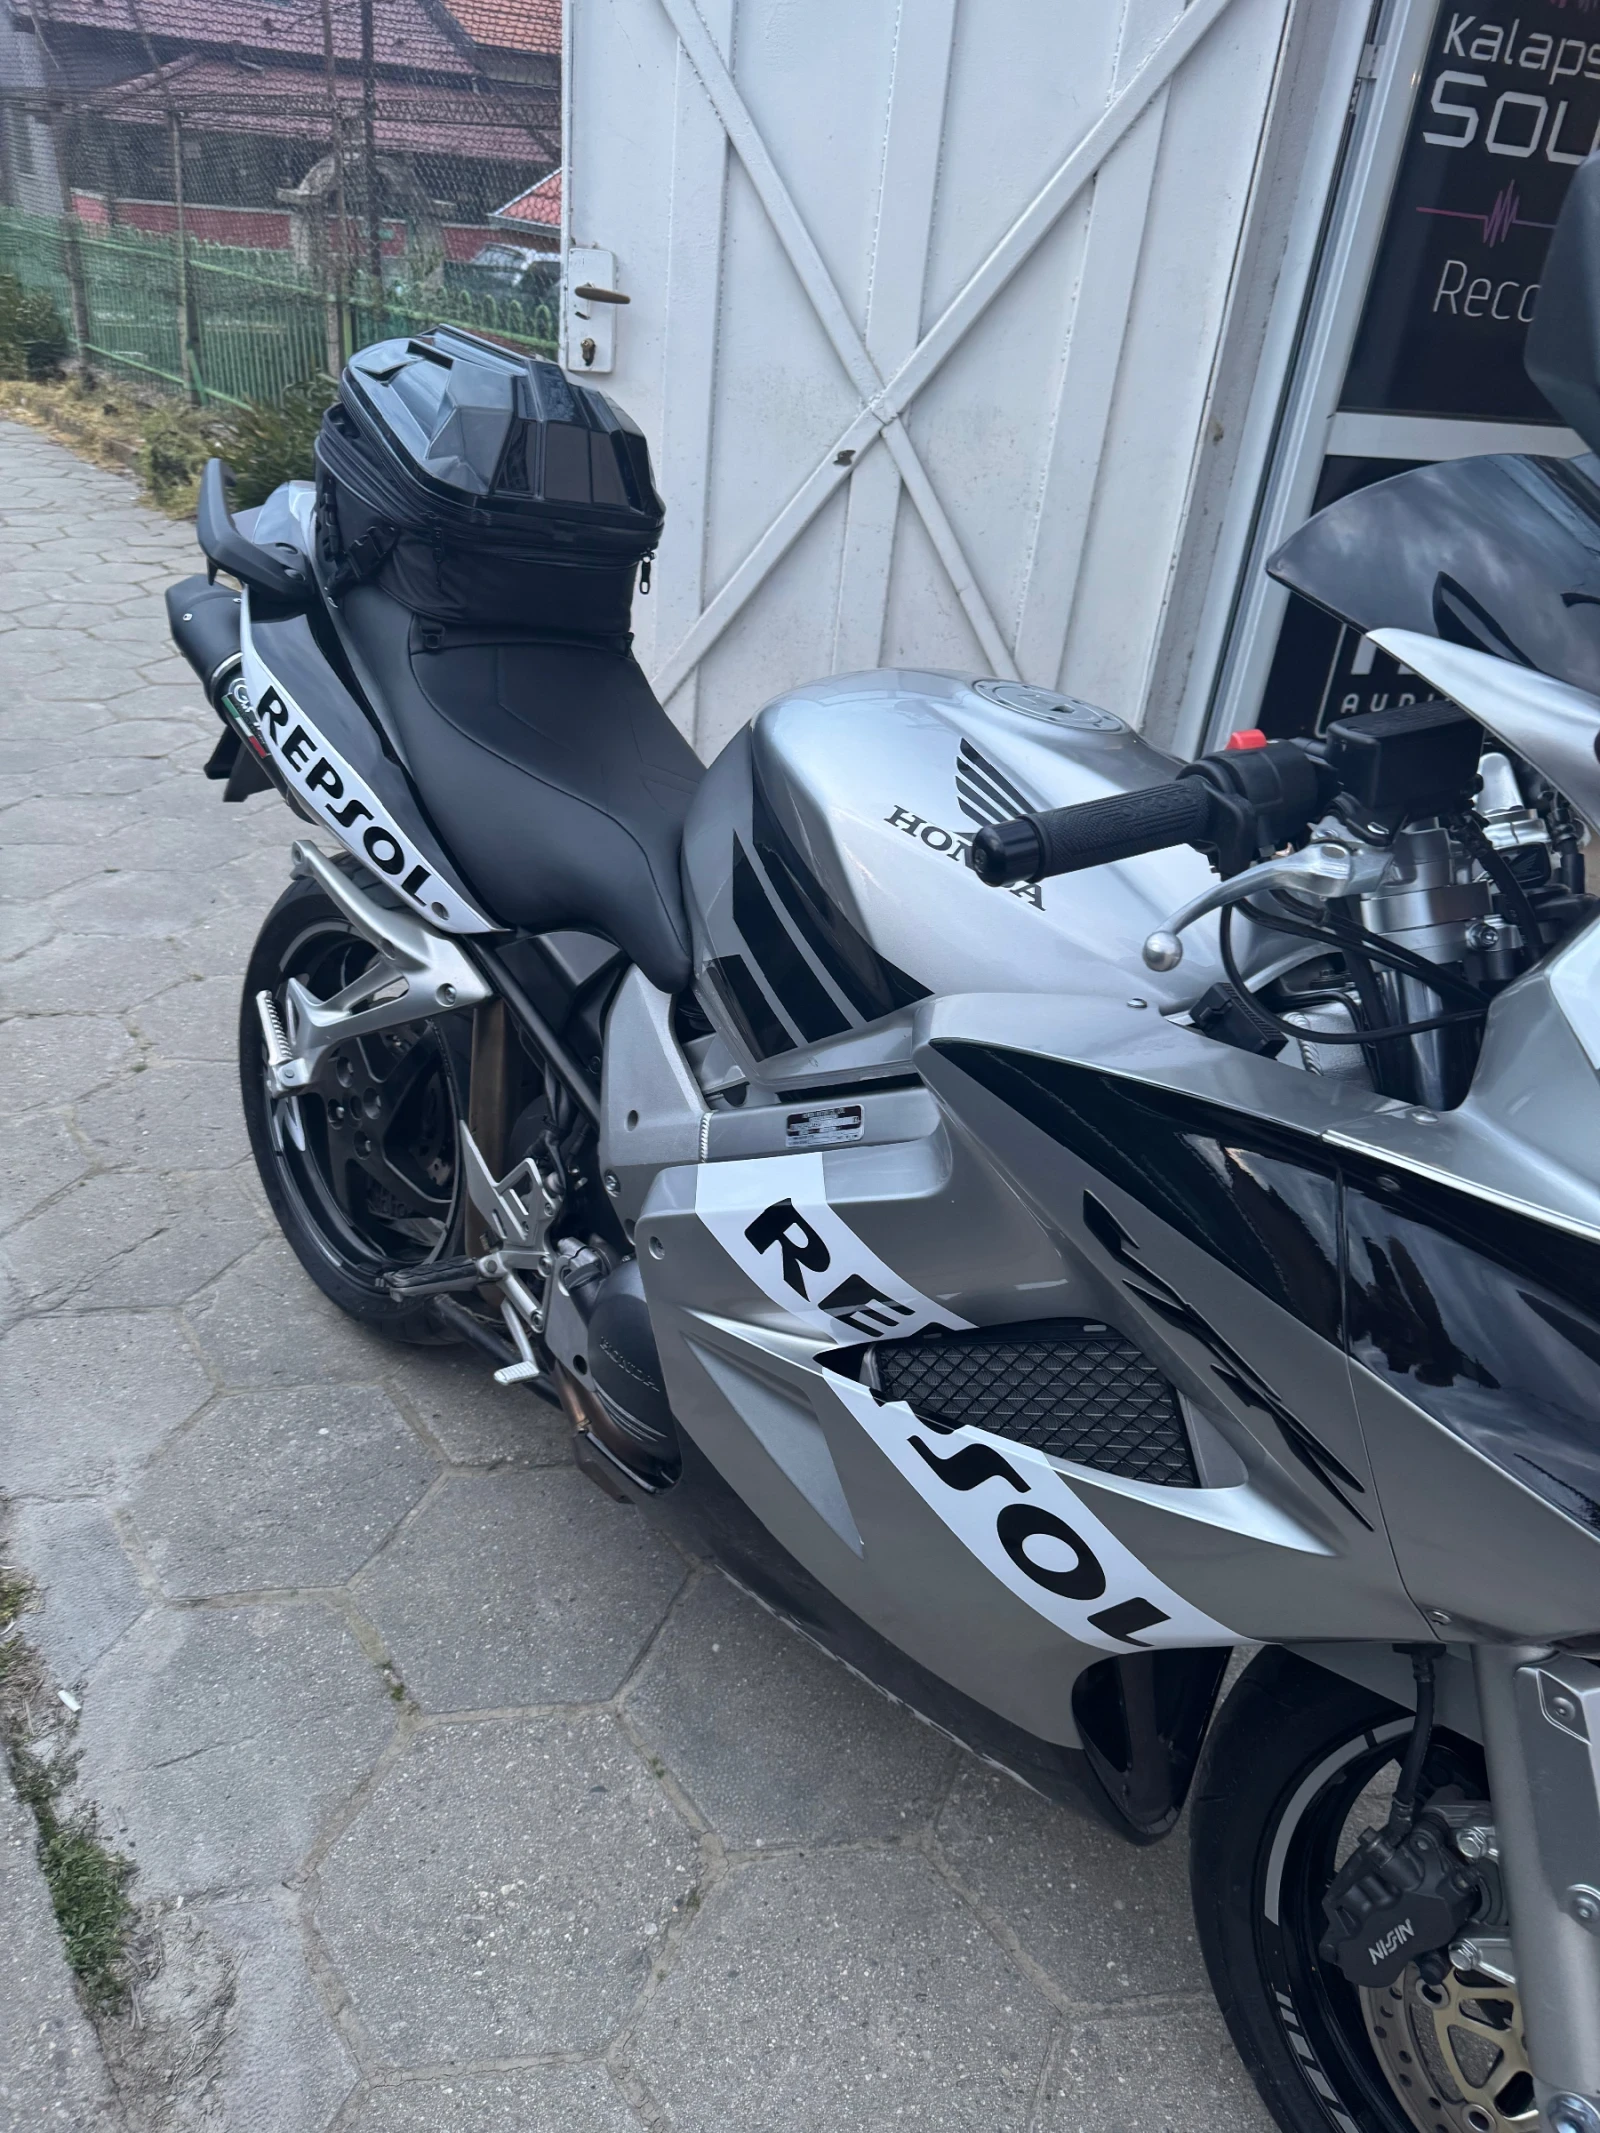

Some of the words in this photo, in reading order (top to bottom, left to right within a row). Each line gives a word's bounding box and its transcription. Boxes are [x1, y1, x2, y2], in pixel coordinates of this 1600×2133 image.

[257, 684, 432, 908] REPSOL
[884, 804, 1047, 912] HONA
[1368, 1917, 1415, 1966] NISSIN
